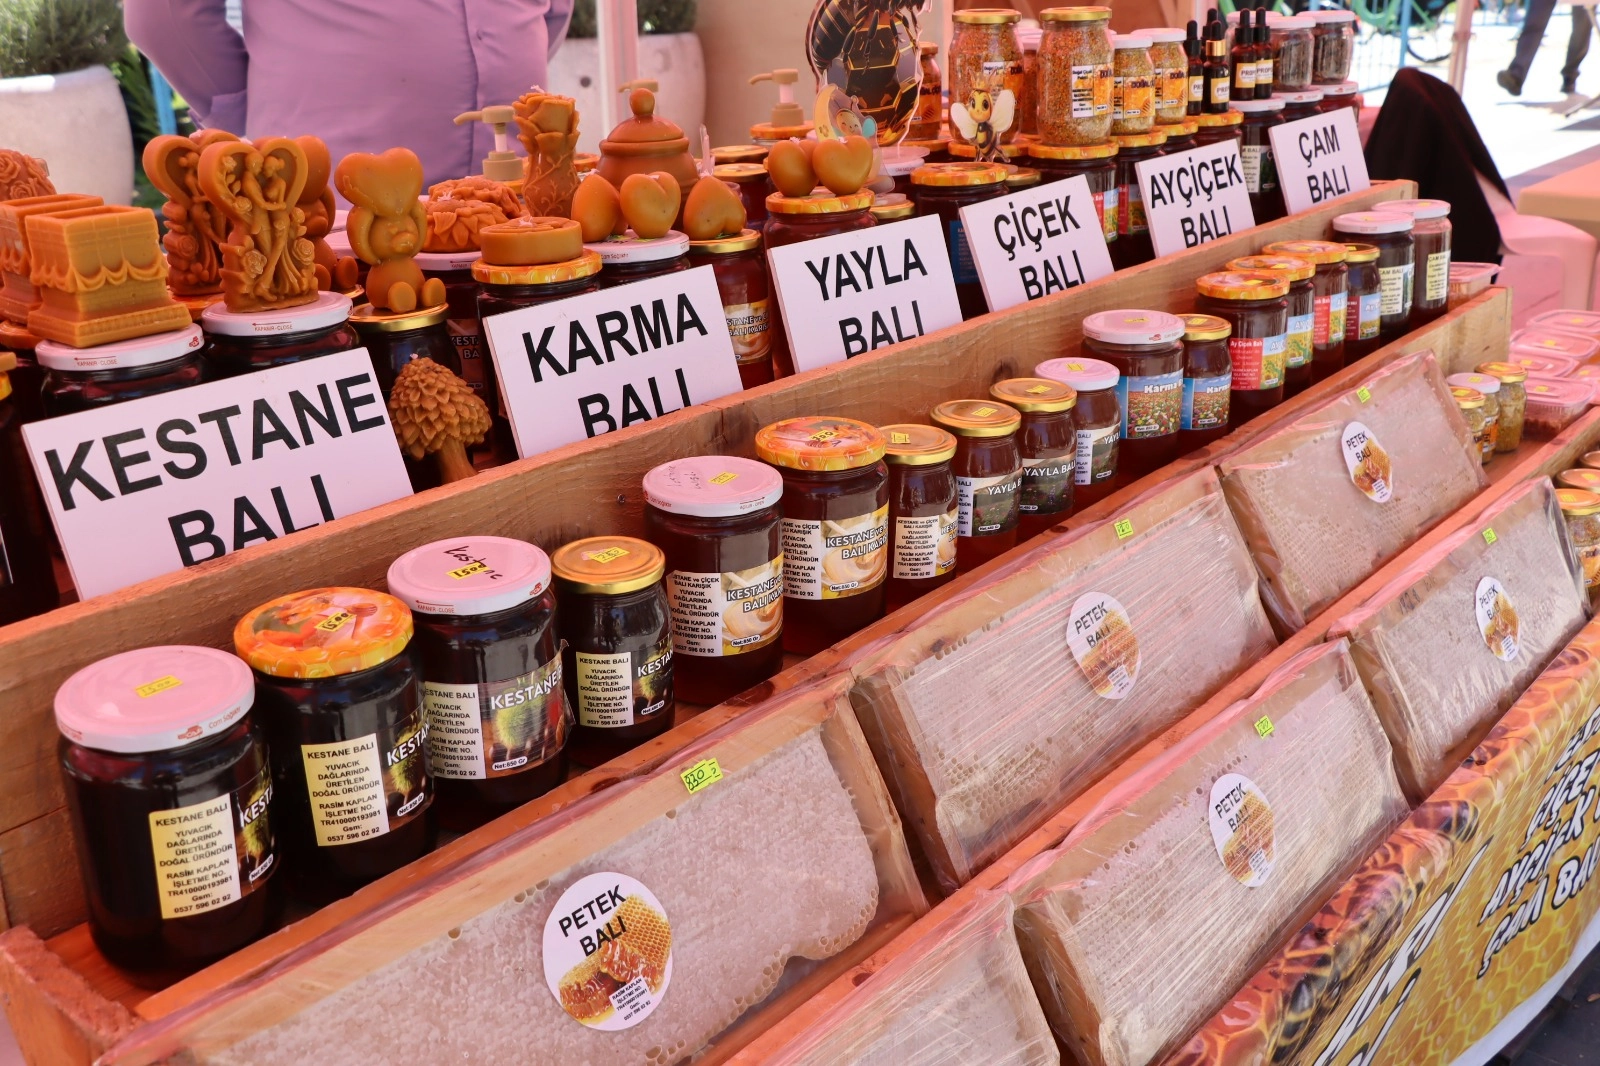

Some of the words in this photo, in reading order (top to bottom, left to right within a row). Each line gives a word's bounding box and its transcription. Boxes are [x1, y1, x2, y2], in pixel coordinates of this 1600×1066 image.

[1299, 124, 1341, 169] ÇAM
[1150, 153, 1243, 209] AYÇİÇEK
[1307, 165, 1351, 204] BALI
[993, 195, 1081, 262] ÇİÇEK
[1180, 205, 1233, 249] BALI
[804, 238, 928, 302] YAYLA
[1019, 250, 1087, 301] BALI
[522, 293, 709, 383] KARMA
[838, 301, 925, 360] BALI
[578, 368, 692, 439] BALI
[44, 373, 386, 511] KESTANE
[1346, 430, 1369, 451] PETEK
[1024, 467, 1060, 477] YAYLA
[988, 482, 1017, 496] YAYLA
[168, 474, 336, 568] BALI
[826, 528, 876, 549] KESTANE
[842, 545, 867, 560] BALI
[727, 580, 775, 601] KESTANE
[743, 597, 768, 613] BALI
[1074, 600, 1108, 635] PETEK
[1086, 625, 1111, 649] BALI
[491, 671, 559, 711] KESTANE
[432, 702, 462, 711] YUVACIK
[432, 718, 466, 727] ÜRETİLEN
[444, 726, 480, 735] ÜRÜNDÜR
[307, 748, 352, 760] KESTANE
[353, 742, 374, 754] BALI
[317, 766, 370, 781] DAĞLARINDA
[325, 760, 360, 772] YUVACIK
[444, 761, 461, 769] Gsm:
[312, 786, 341, 798] DOĞAL
[342, 780, 381, 795] ÜRÜNDÜR
[326, 776, 365, 789] ÜRETİLEN
[318, 802, 345, 811] RASİM
[346, 794, 378, 807] KAPLAN
[1214, 782, 1247, 819] PETEK
[155, 812, 204, 827] KESTANE
[206, 802, 228, 817] BALI
[325, 808, 359, 819] İŞLETME
[360, 804, 374, 813] NO.
[175, 824, 213, 838] YUVACIK
[327, 834, 345, 842] 0537
[346, 832, 360, 840] 596
[371, 826, 380, 834] 92
[342, 824, 363, 833] Gsm:
[166, 830, 223, 849] DAĞLARINDA
[175, 840, 217, 857] ÜRETİLEN
[159, 856, 190, 868] DOĞAL
[192, 843, 234, 862] ÜRÜNDÜR
[166, 868, 195, 880] RASİM
[196, 858, 230, 875] KAPLAN
[173, 873, 210, 889] İŞLETME
[212, 870, 226, 880] NO.
[174, 904, 193, 914] 0537
[196, 901, 210, 910] 596
[211, 898, 221, 906] 02
[222, 894, 232, 903] 92
[192, 892, 213, 902] Gsm:
[558, 884, 627, 938] PETEK
[580, 915, 627, 957] BALI
